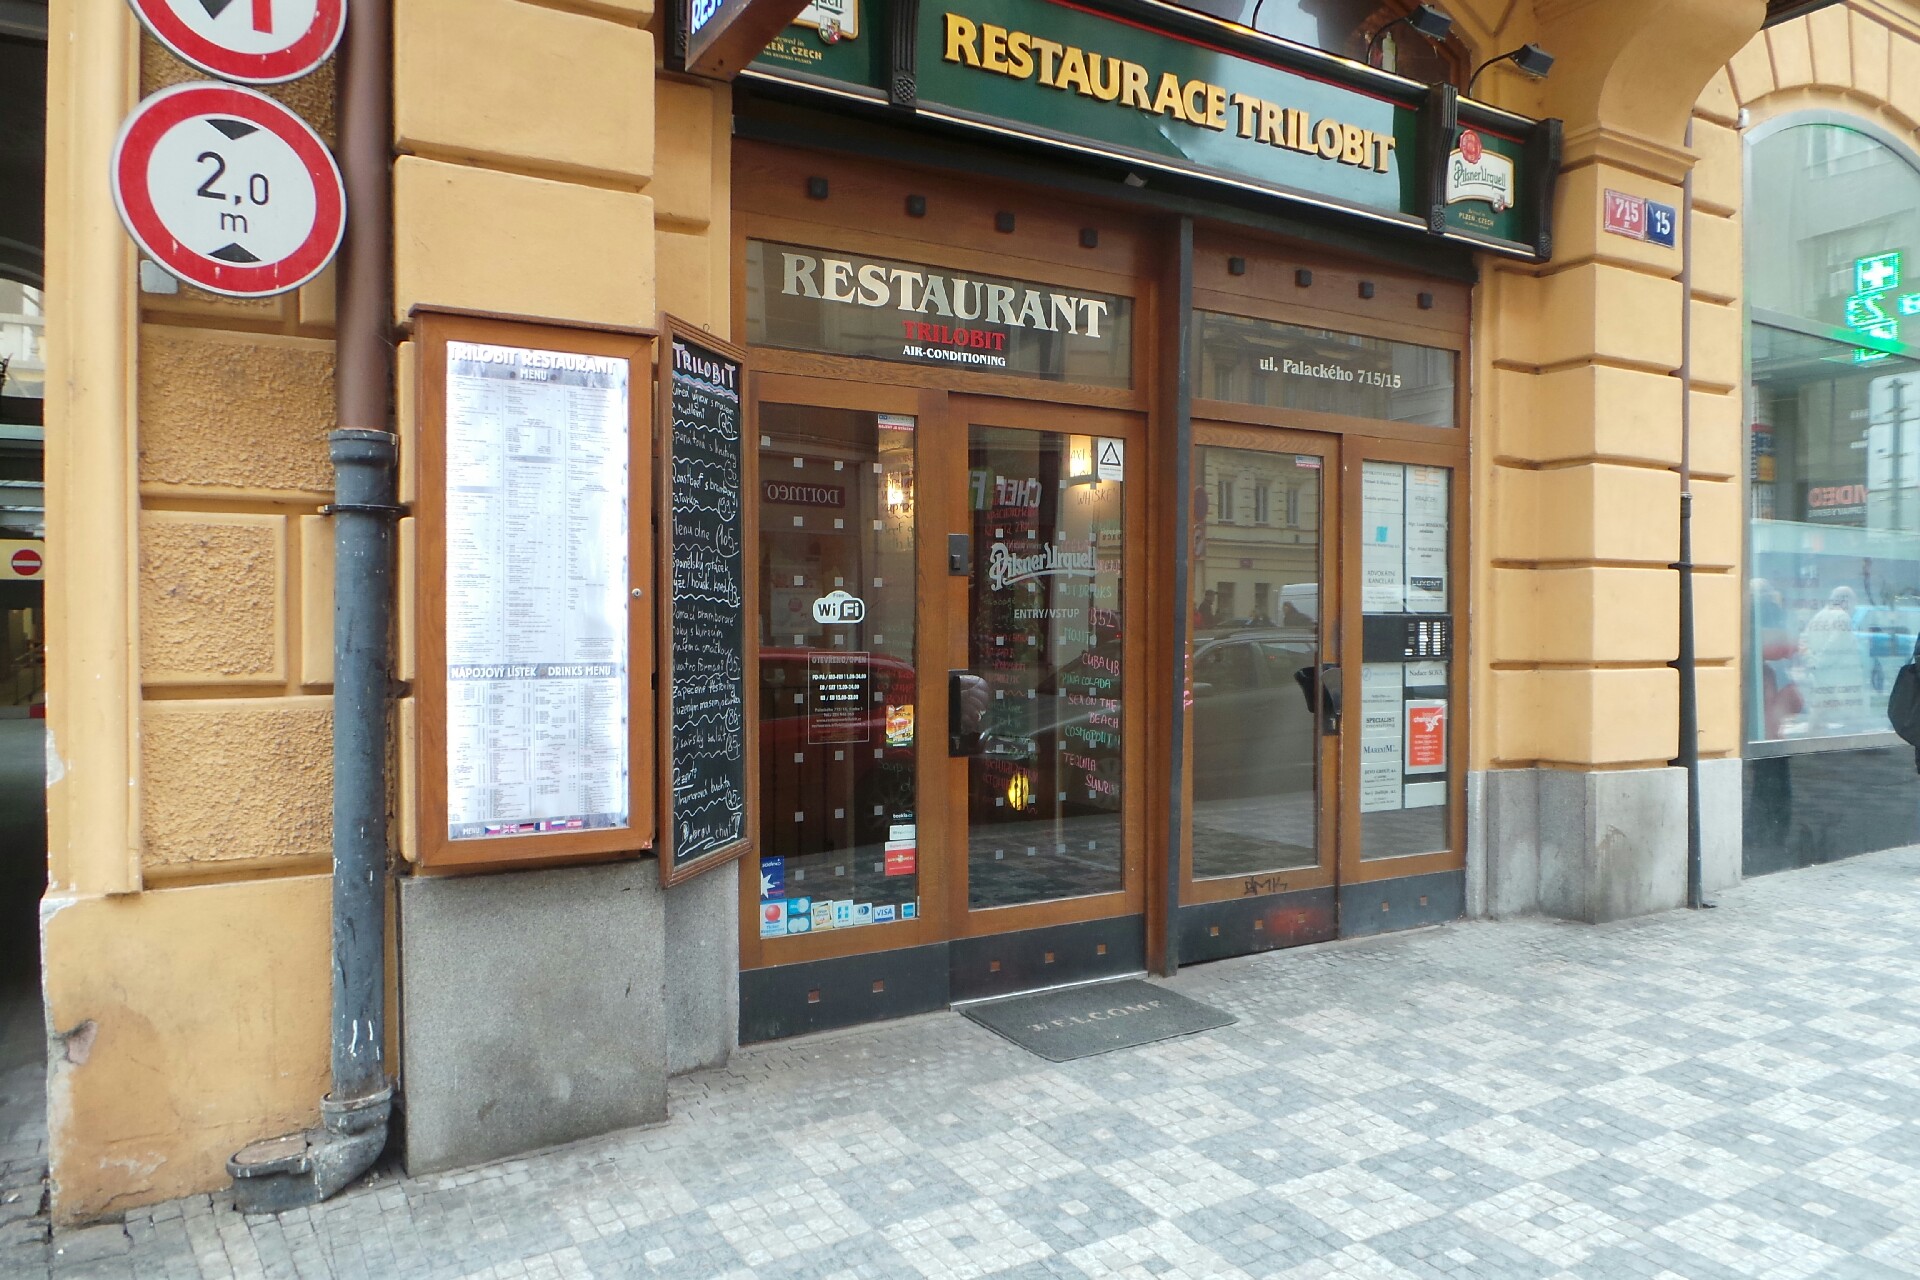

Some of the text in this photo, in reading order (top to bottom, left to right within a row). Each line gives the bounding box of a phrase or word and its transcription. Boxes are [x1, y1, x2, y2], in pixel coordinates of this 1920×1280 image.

[691, 0, 724, 35] RES
[791, 46, 823, 60] CZECH
[944, 13, 1396, 174] RESTAURACE TRILOBIT
[196, 151, 270, 206] 2,0
[1454, 160, 1506, 190] Pilsner Urquell
[220, 211, 249, 234] m
[1616, 200, 1639, 222] 715
[1655, 212, 1671, 235] 15
[782, 252, 1107, 340] RESTAURANT
[903, 320, 1006, 350] TRILOBIT
[452, 344, 616, 376] TRILOBIT RESTAURANT
[672, 341, 736, 388] TRILOBIT
[902, 344, 1006, 367] AIR-CONDITIONING
[520, 368, 549, 382] MENU
[1259, 356, 1402, 389] ul. Palackého 715/15
[988, 541, 1097, 592] Pilsner Urquell
[548, 665, 583, 677] DRINKS
[585, 664, 611, 676] MENU
[1081, 652, 1120, 677] CUBA LIB
[1081, 675, 1112, 689] COLADA
[1099, 697, 1118, 713] THE
[1088, 710, 1119, 729] BEACH
[876, 908, 893, 916] VISA
[1027, 1000, 1168, 1032] WELCOME
